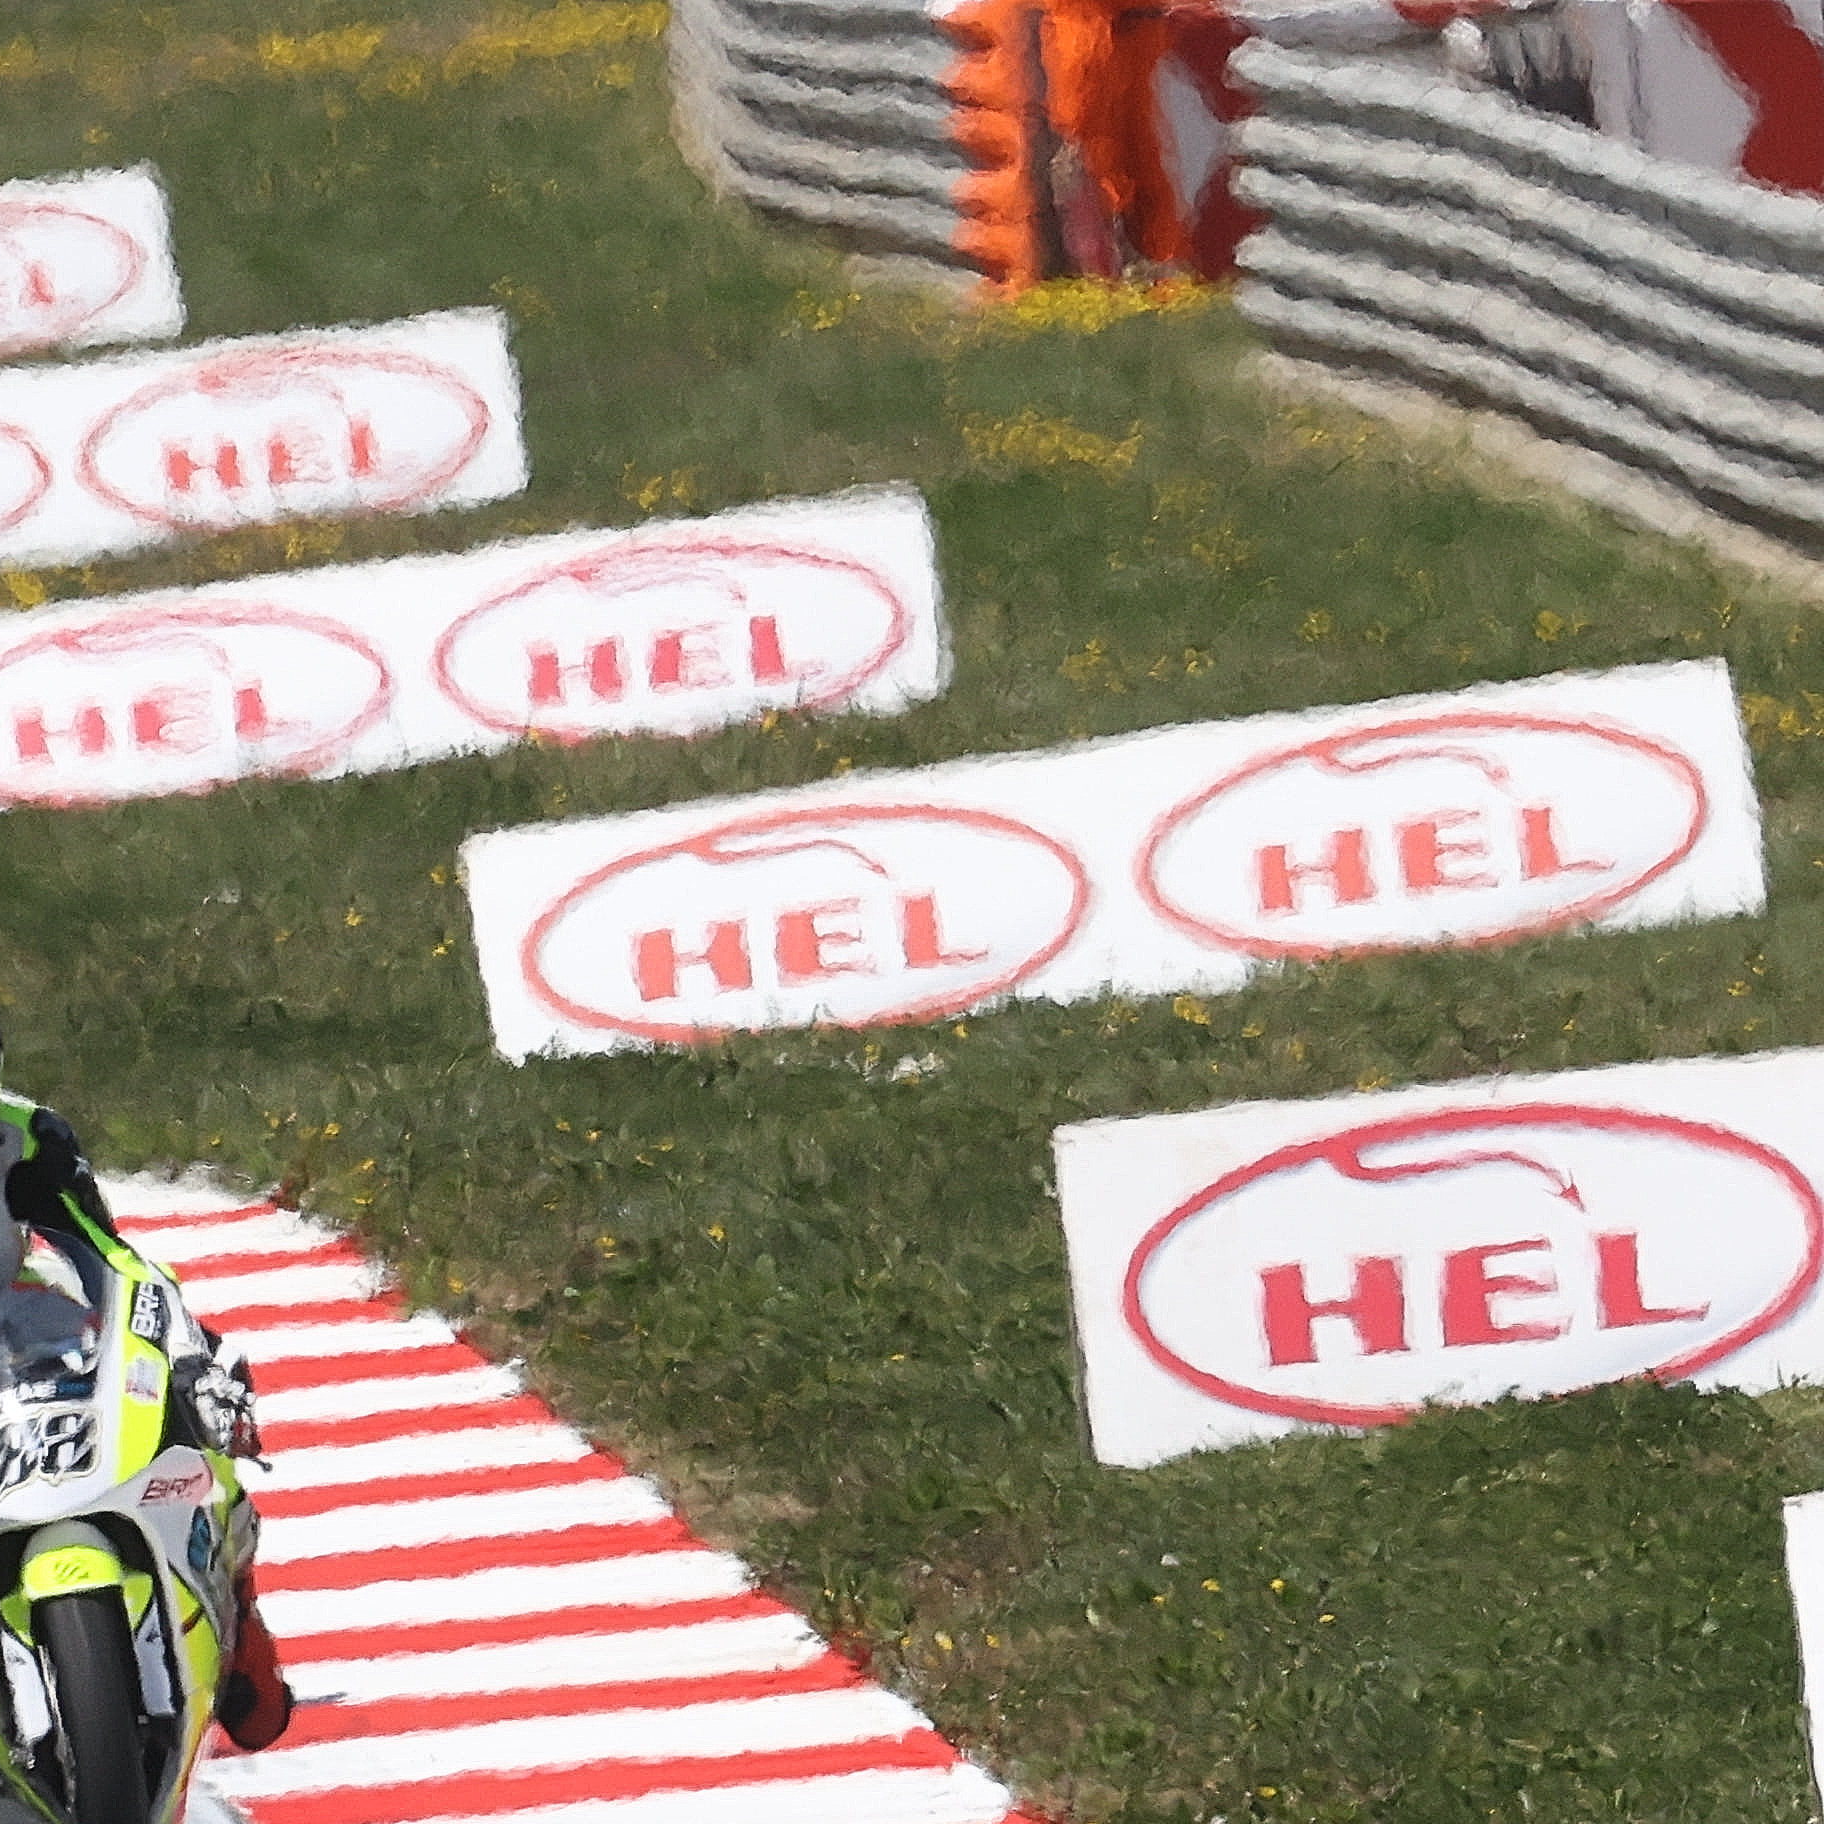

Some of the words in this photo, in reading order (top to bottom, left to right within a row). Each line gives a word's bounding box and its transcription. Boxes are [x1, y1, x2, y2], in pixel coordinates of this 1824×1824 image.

[165, 420, 394, 499] HEL
[528, 615, 824, 708] HEL
[14, 683, 304, 766] HEL
[1256, 806, 1614, 918] HEL
[634, 893, 987, 1003] HEL
[1259, 1231, 1709, 1369] HEL
